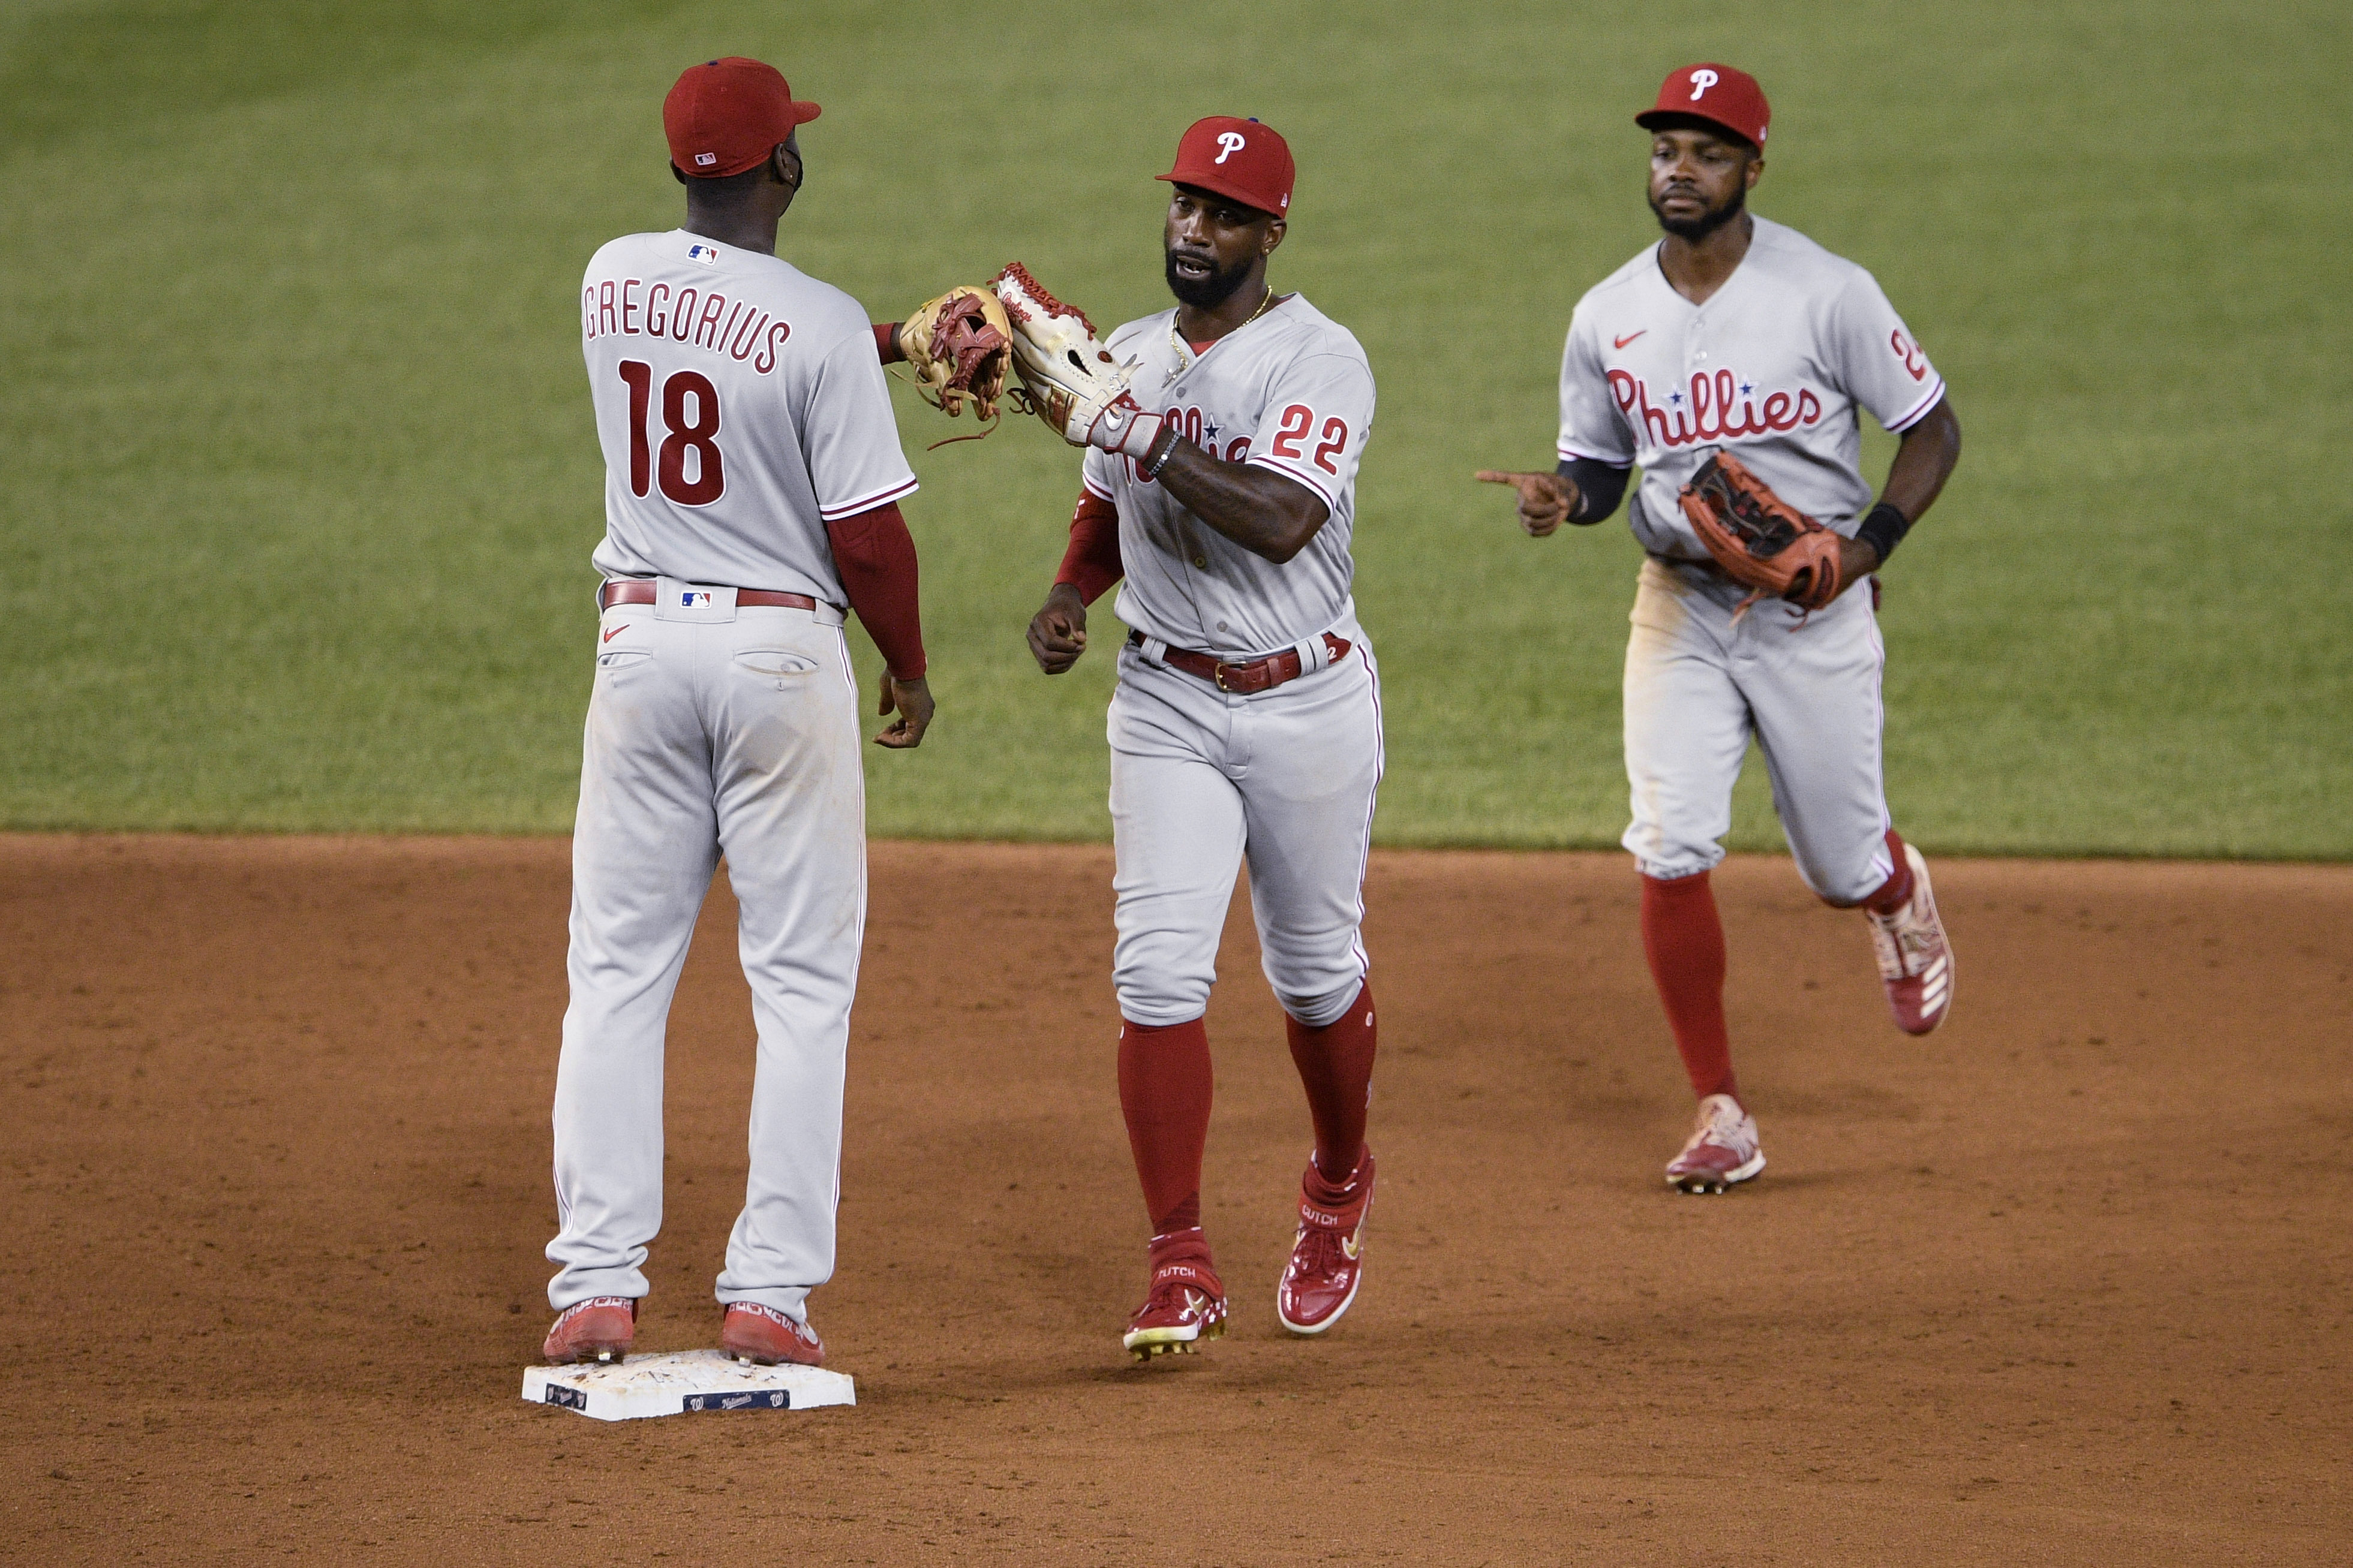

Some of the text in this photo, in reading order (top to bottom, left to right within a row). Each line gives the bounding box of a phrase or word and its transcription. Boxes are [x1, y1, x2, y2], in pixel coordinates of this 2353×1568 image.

[1689, 69, 1719, 101] P
[1215, 131, 1246, 164] P
[583, 278, 791, 375] GREGORIUS
[1889, 329, 1927, 382] 2
[618, 359, 726, 507] 18
[1271, 402, 1348, 477] 22
[1607, 366, 1823, 449] Phillies
